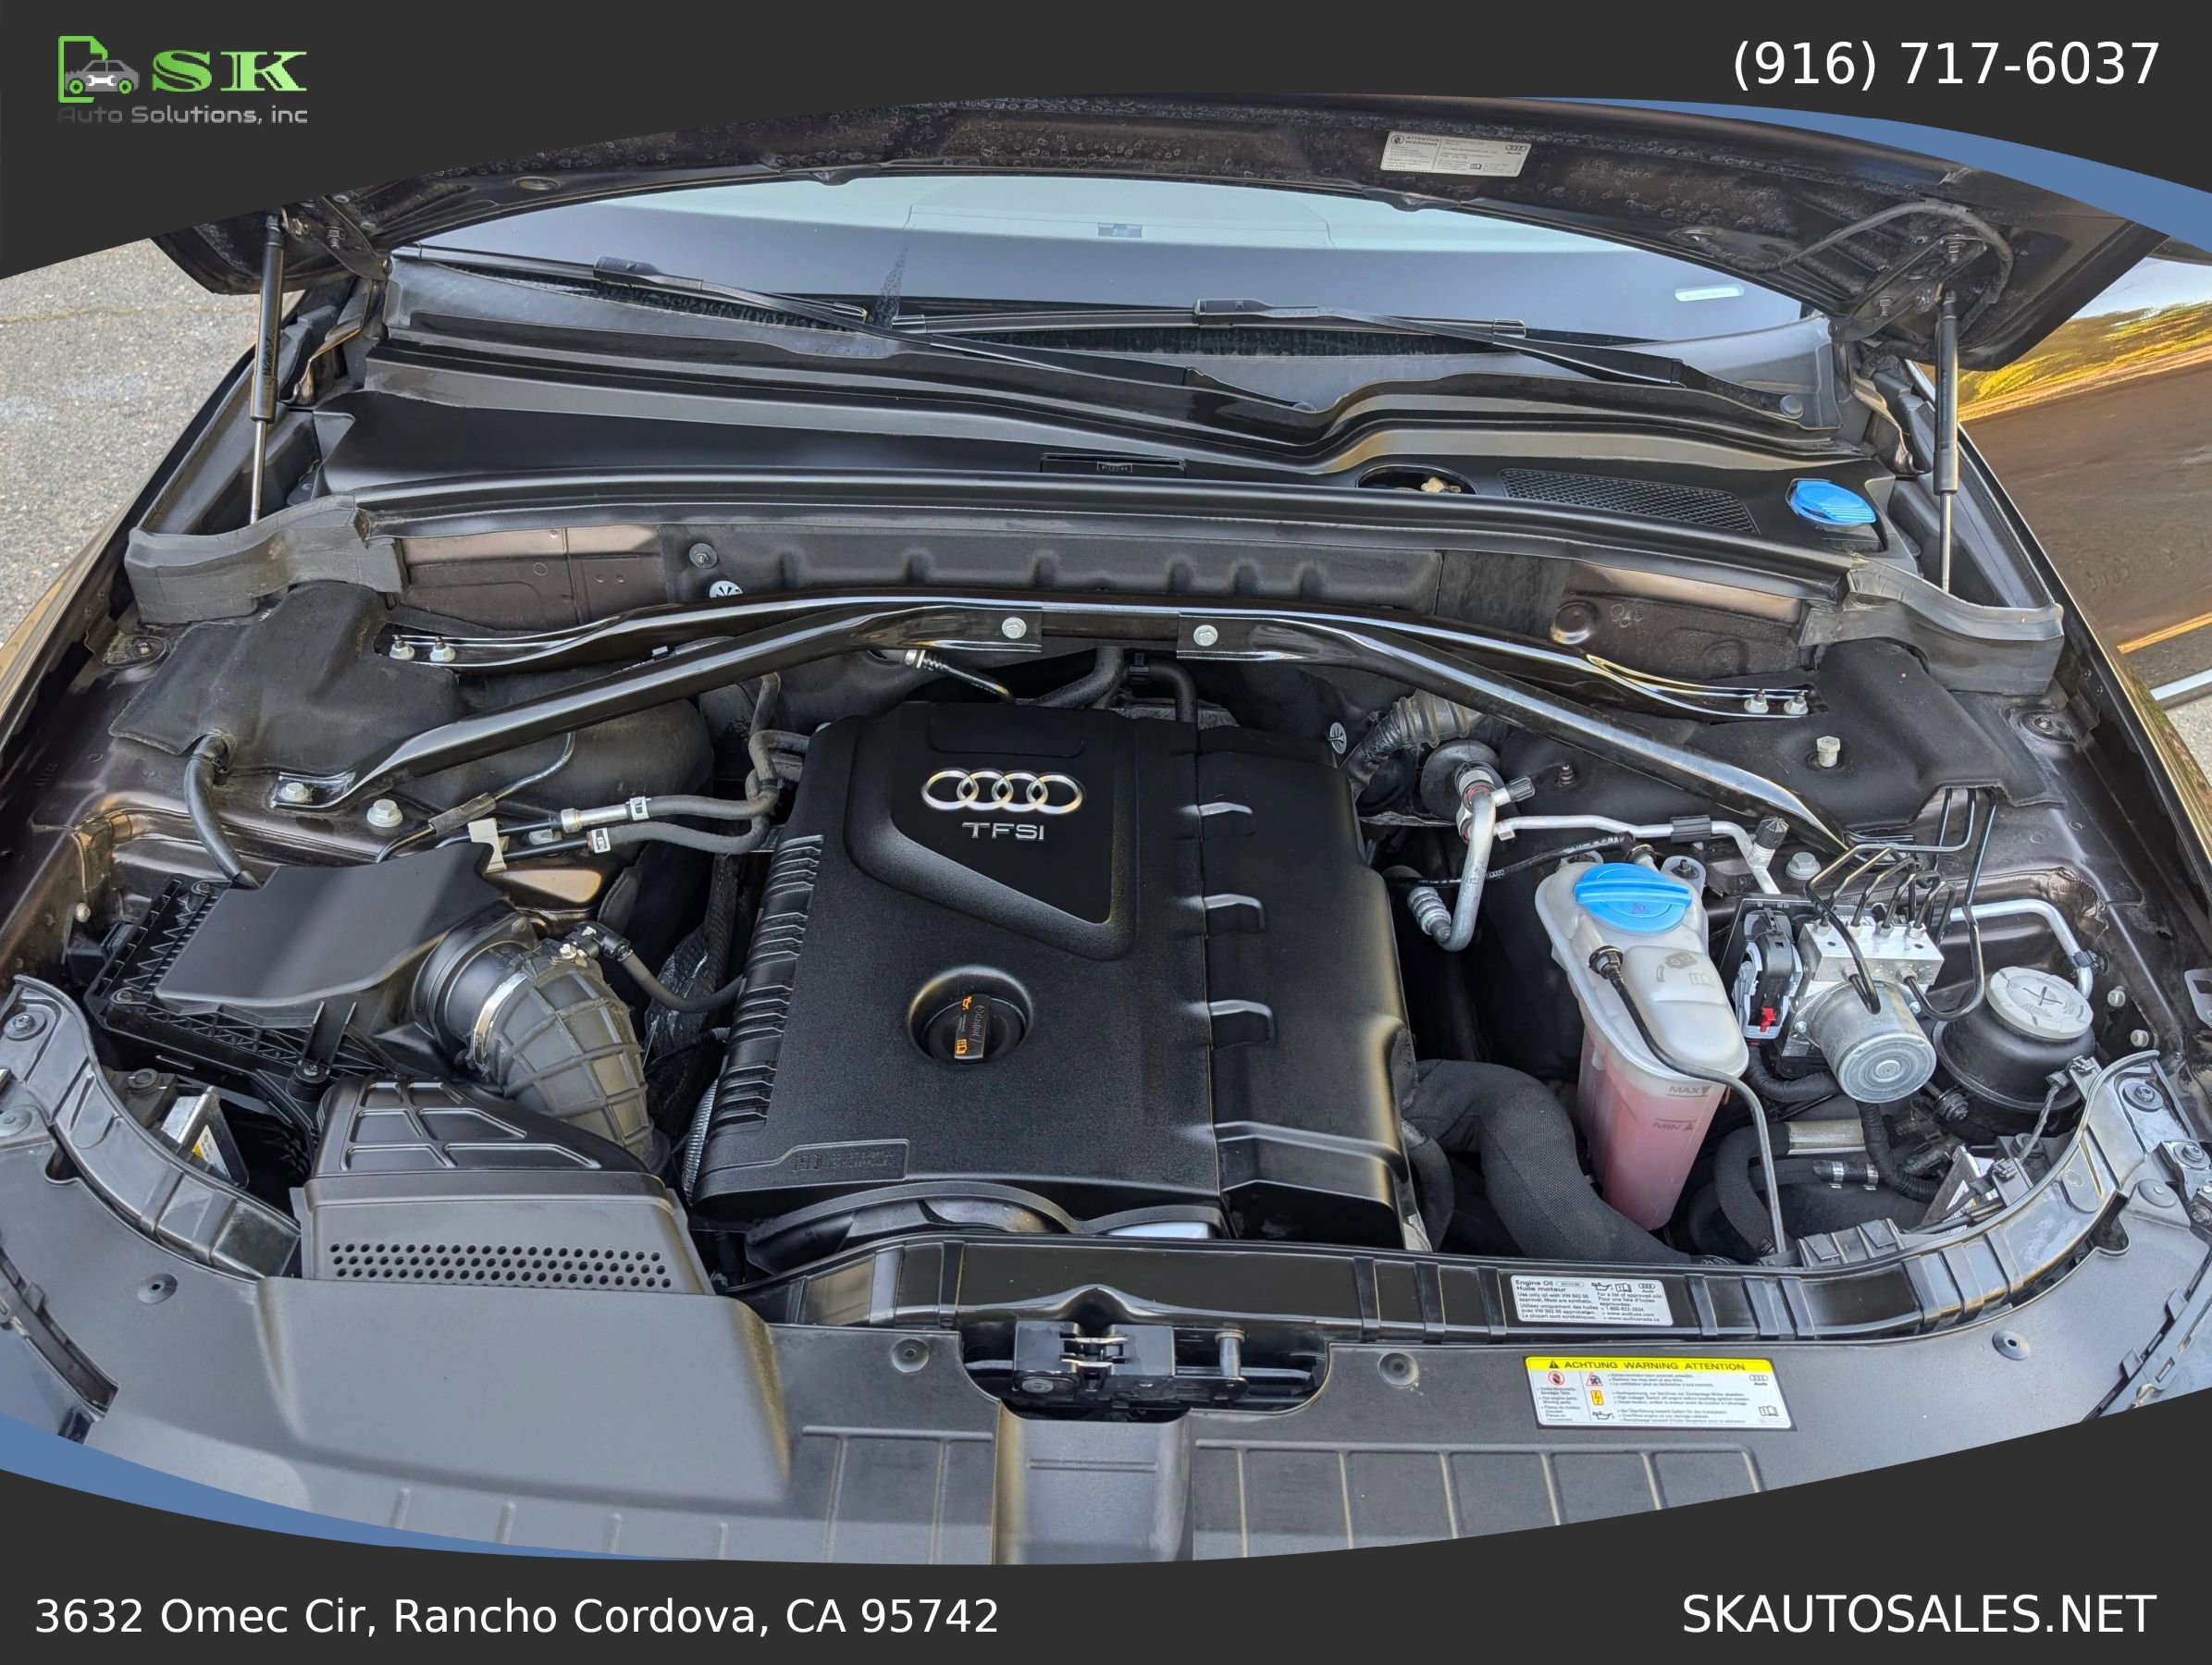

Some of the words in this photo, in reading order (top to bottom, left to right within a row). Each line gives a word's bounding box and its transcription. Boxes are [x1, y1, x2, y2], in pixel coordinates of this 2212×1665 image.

[962, 821, 1044, 842] TFSI
[1669, 1086, 1700, 1094] MAX
[1652, 1122, 1681, 1130] MIN
[1564, 1361, 1618, 1369] ACHTUNG
[1624, 1362, 1679, 1370] WARNING
[1685, 1363, 1746, 1371] ATTENTION
